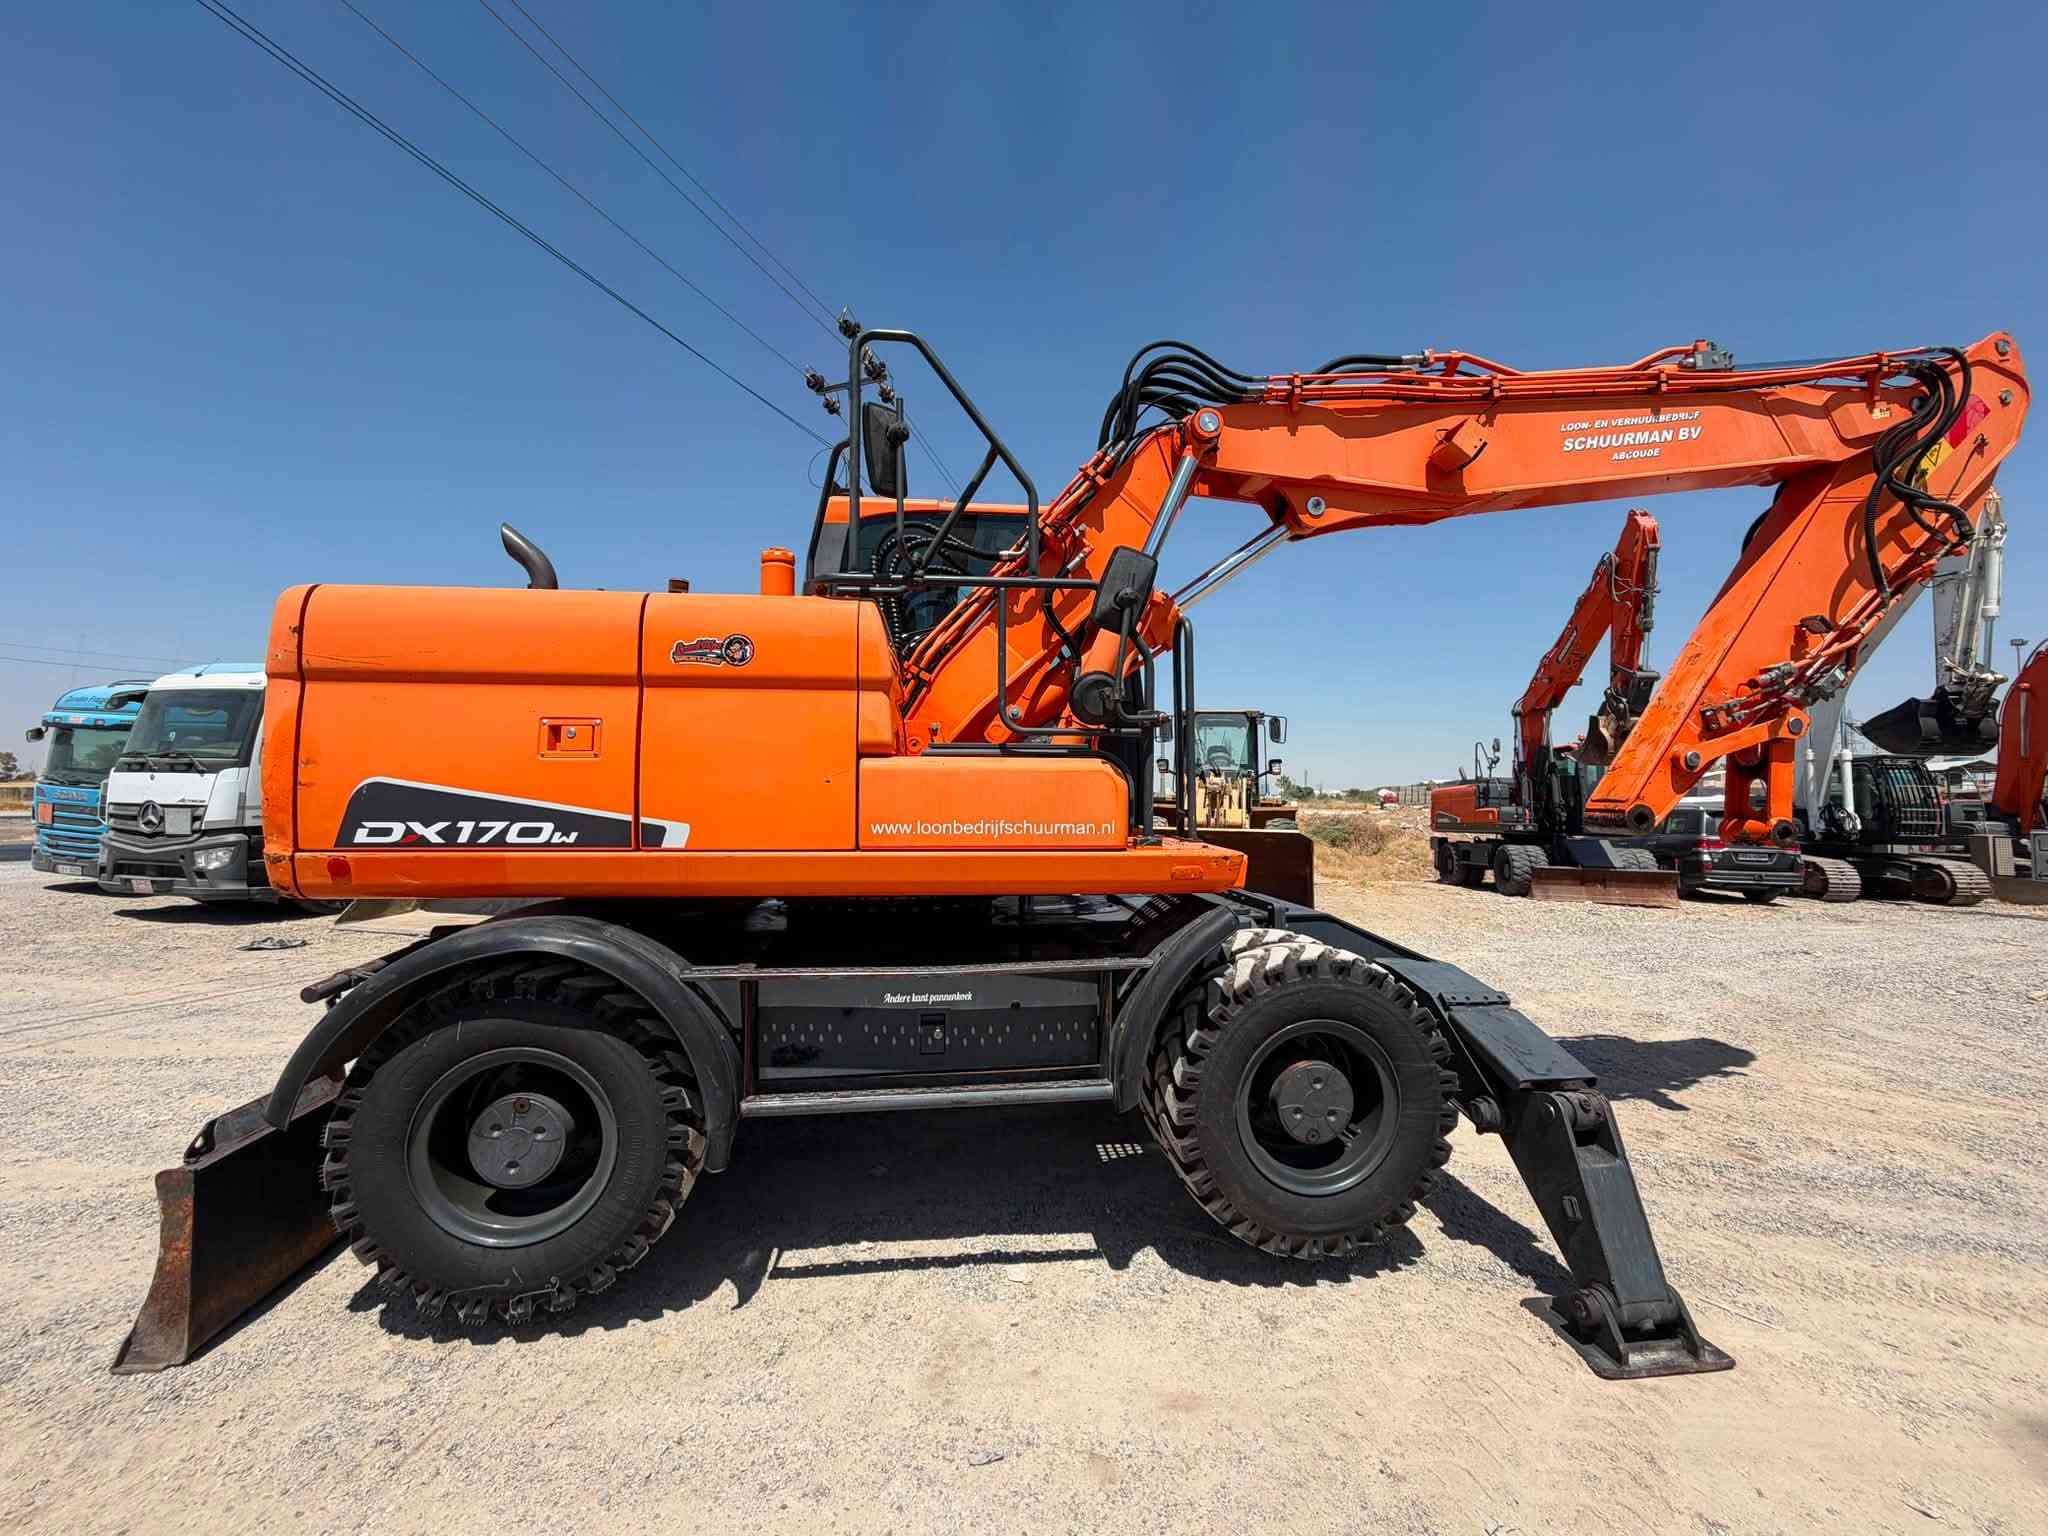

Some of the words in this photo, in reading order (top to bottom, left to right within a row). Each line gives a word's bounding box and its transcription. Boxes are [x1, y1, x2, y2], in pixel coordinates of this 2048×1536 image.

[1595, 419, 1608, 429] EN
[1563, 430, 1673, 451] SCHUURMAN
[1678, 425, 1702, 441] BV
[1612, 448, 1661, 461] ABCOUDE
[870, 819, 1116, 839] www.loonbedrijfschuurman.nl
[883, 993, 911, 1004] Andere
